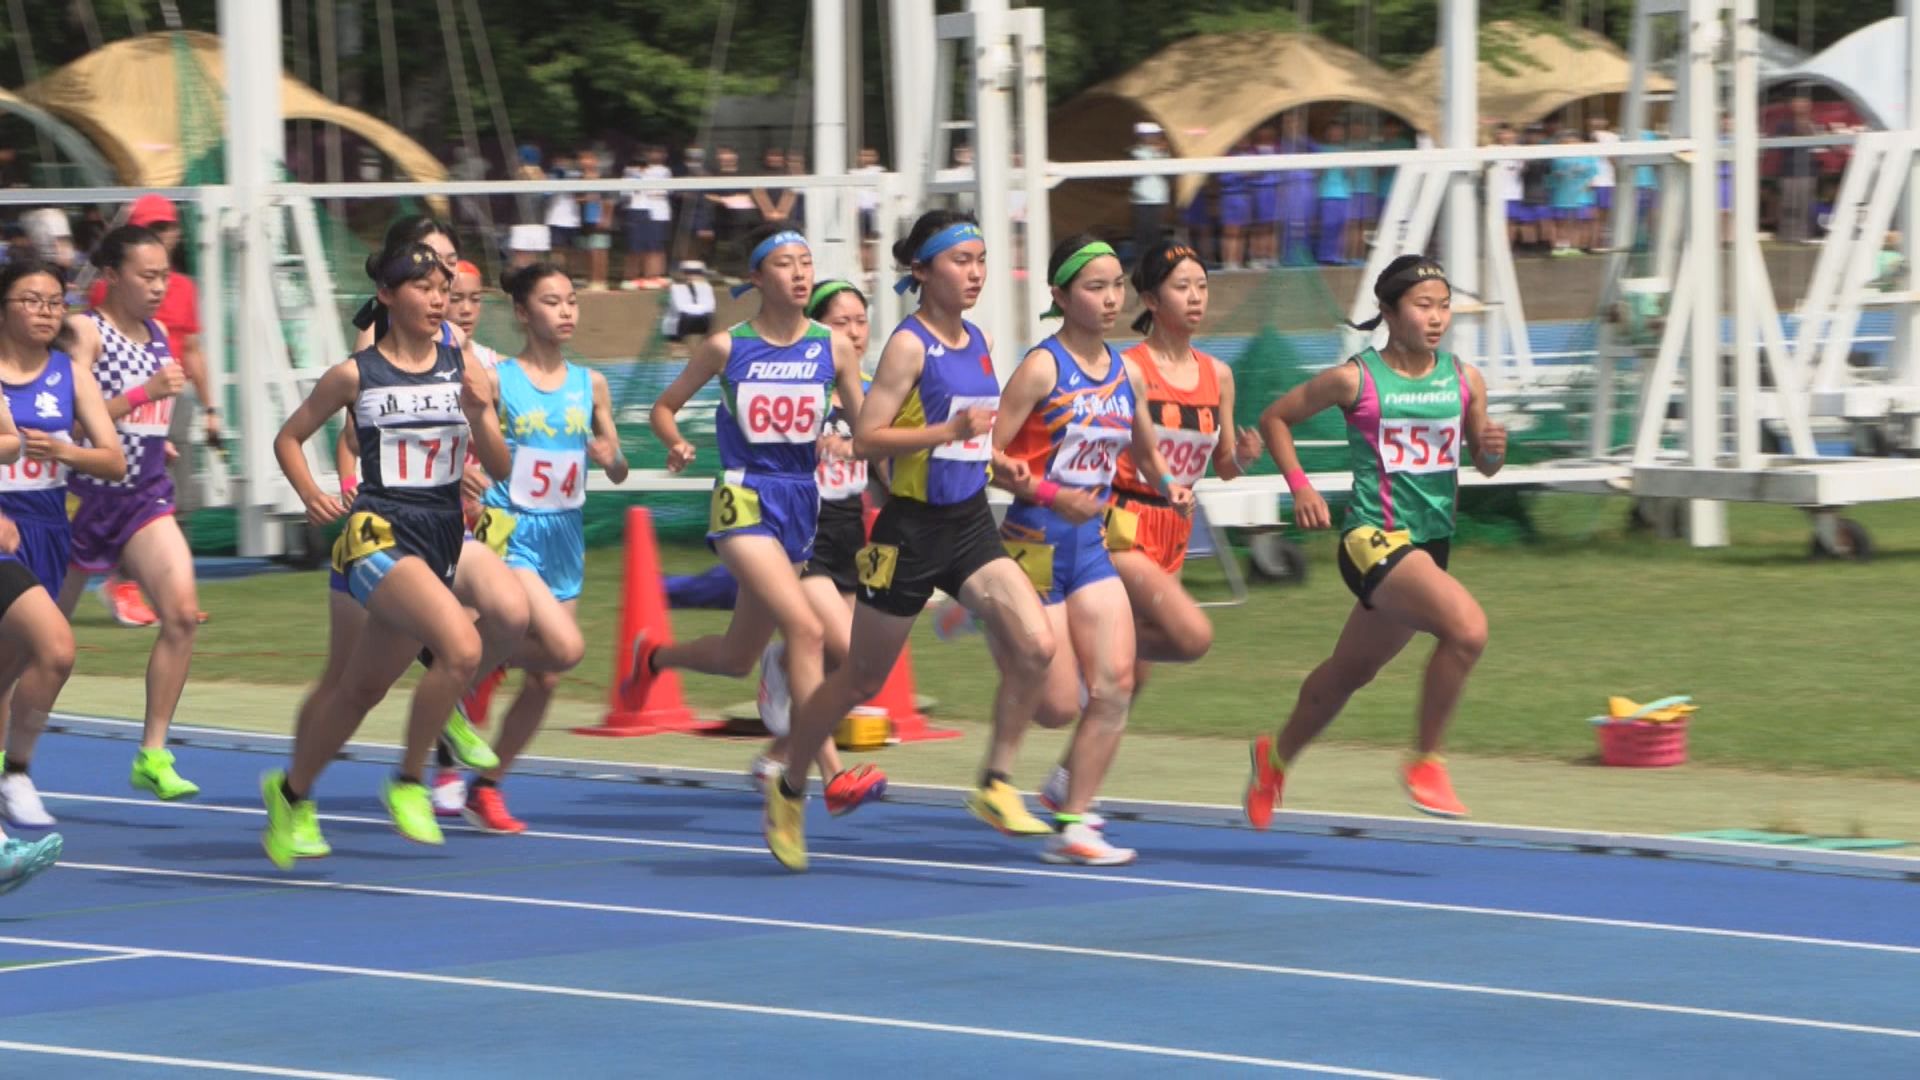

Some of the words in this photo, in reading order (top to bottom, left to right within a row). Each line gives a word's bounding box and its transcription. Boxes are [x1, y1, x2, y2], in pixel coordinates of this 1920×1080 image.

[746, 362, 818, 379] FUZOKU
[749, 394, 816, 434] 695
[1383, 426, 1456, 466] 552
[530, 460, 579, 498] 54
[720, 486, 738, 527] 3
